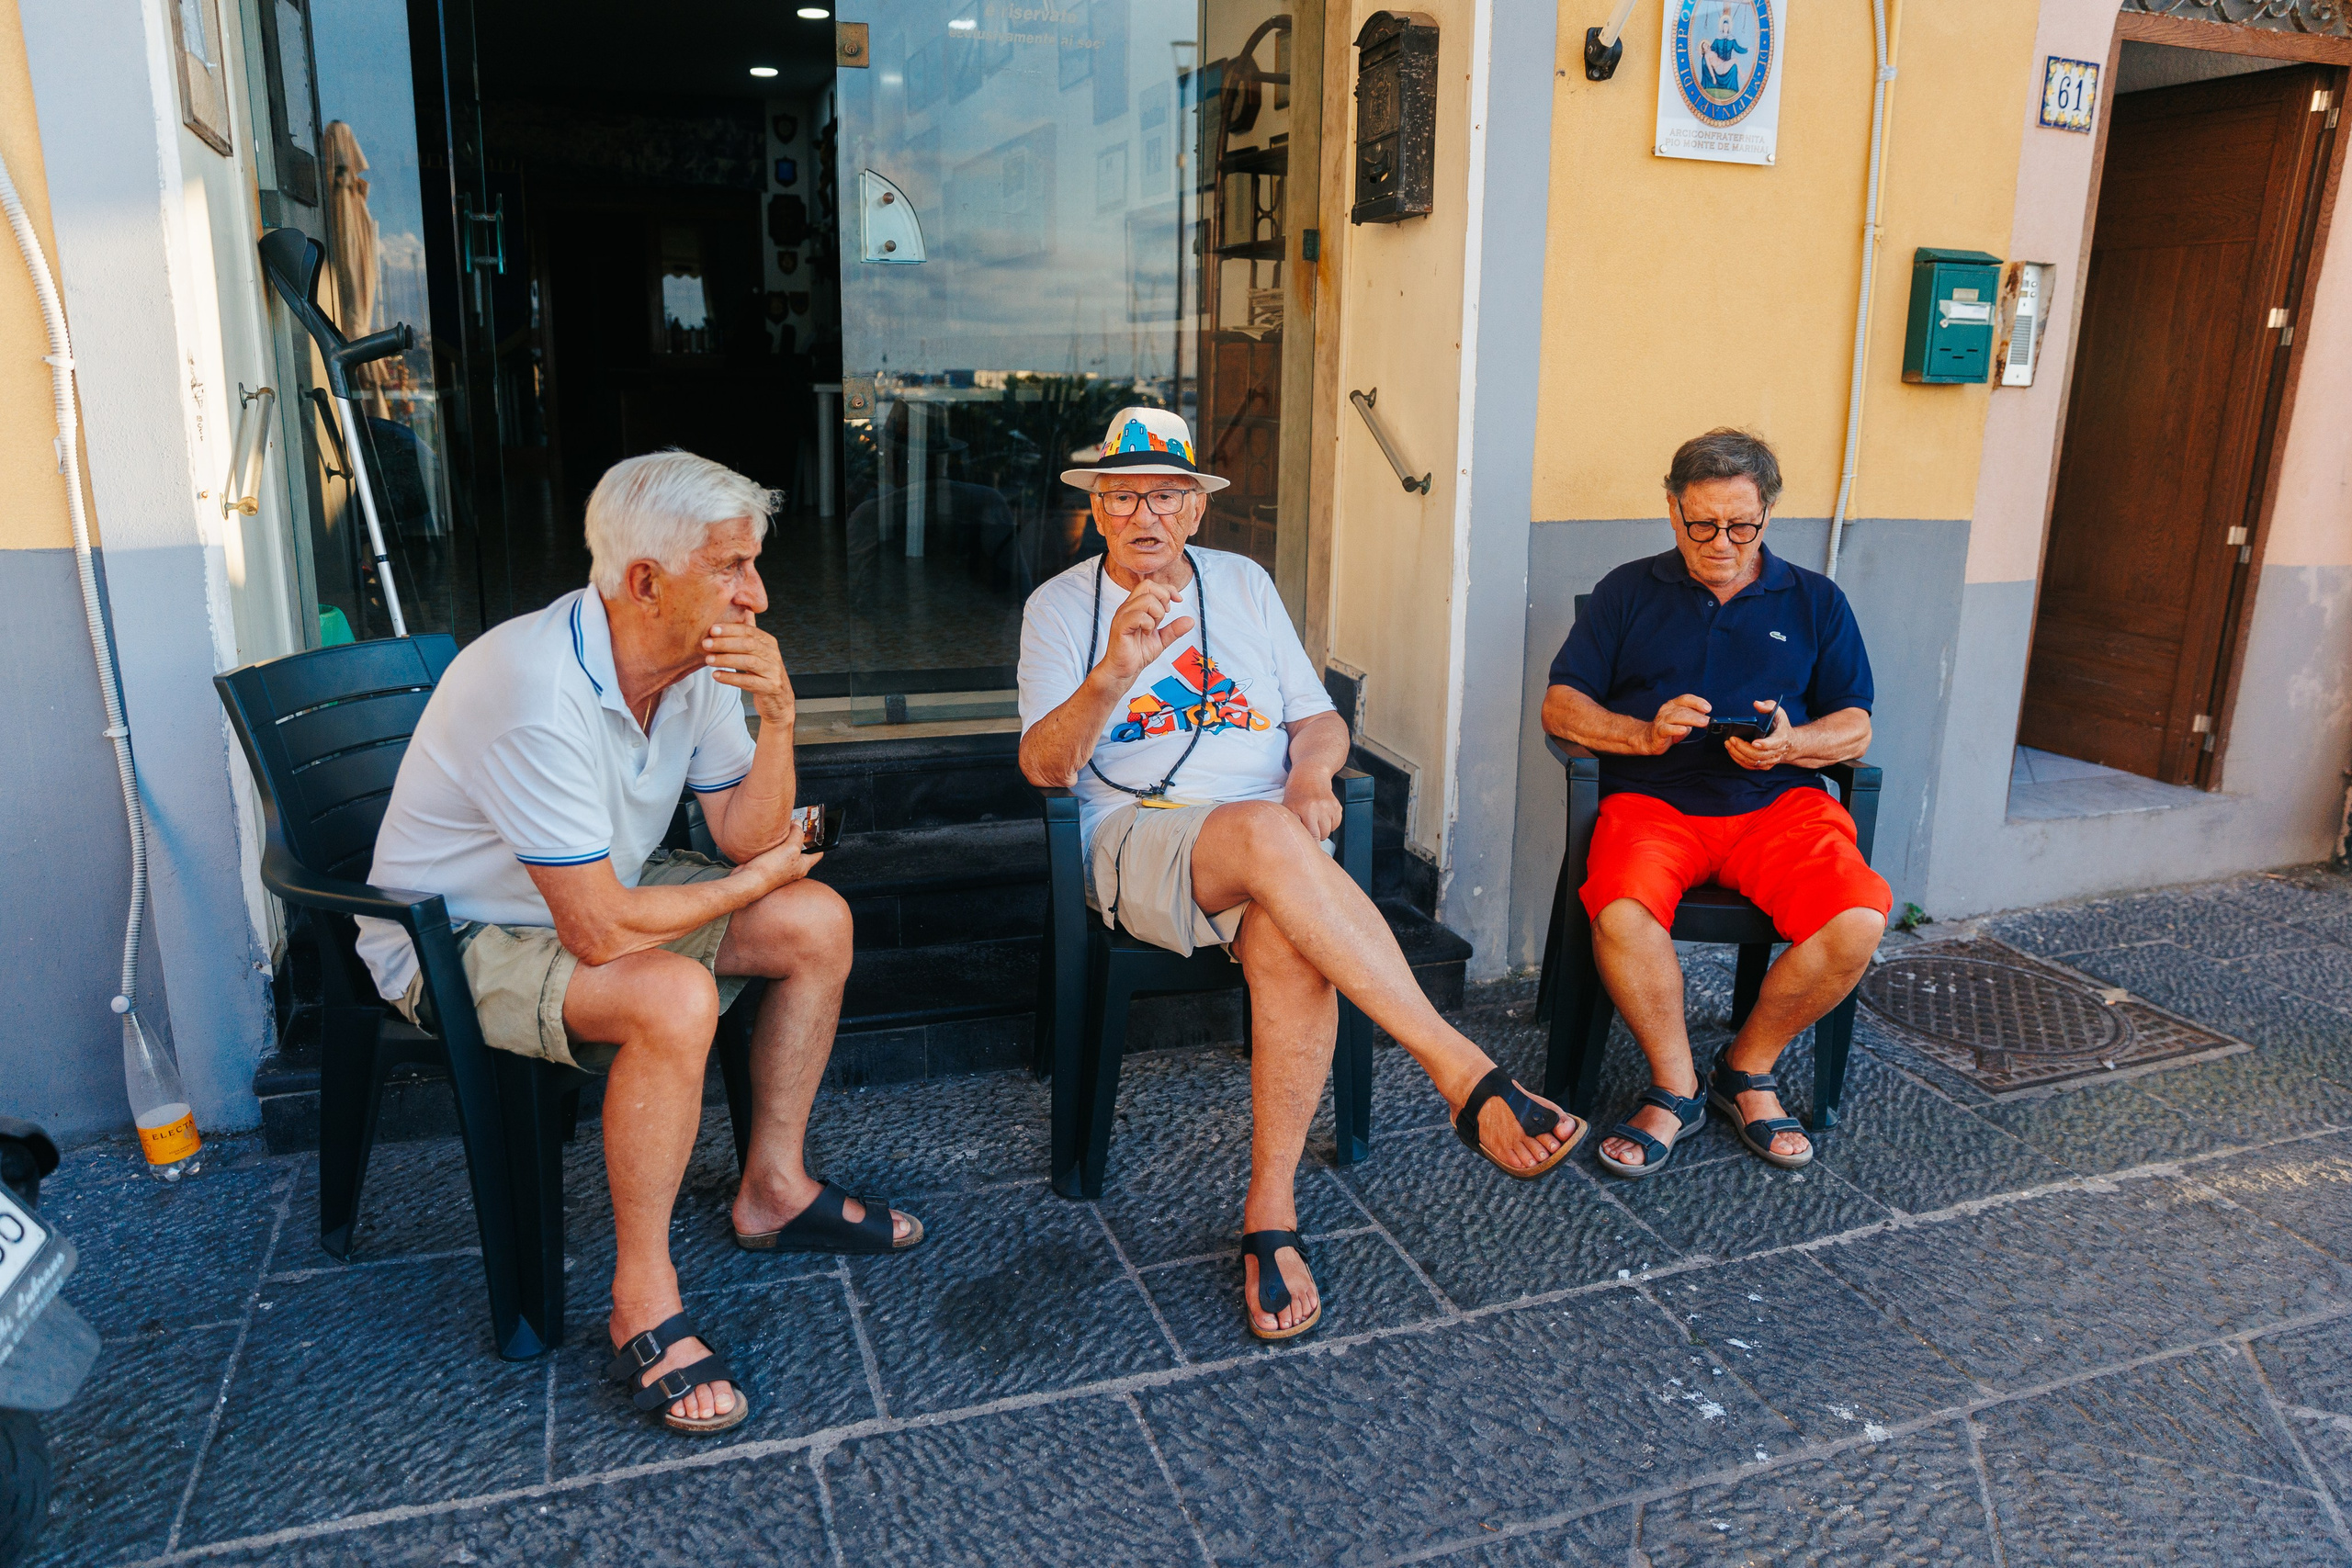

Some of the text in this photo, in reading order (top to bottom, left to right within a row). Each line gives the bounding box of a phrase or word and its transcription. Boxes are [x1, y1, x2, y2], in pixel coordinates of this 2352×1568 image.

[1001, 4, 1078, 24] riservato
[1060, 35, 1073, 46] ai
[2058, 75, 2083, 111] 61
[1665, 138, 1680, 147] PIO
[1683, 140, 1715, 150] MONTE
[1717, 142, 1729, 151] DE
